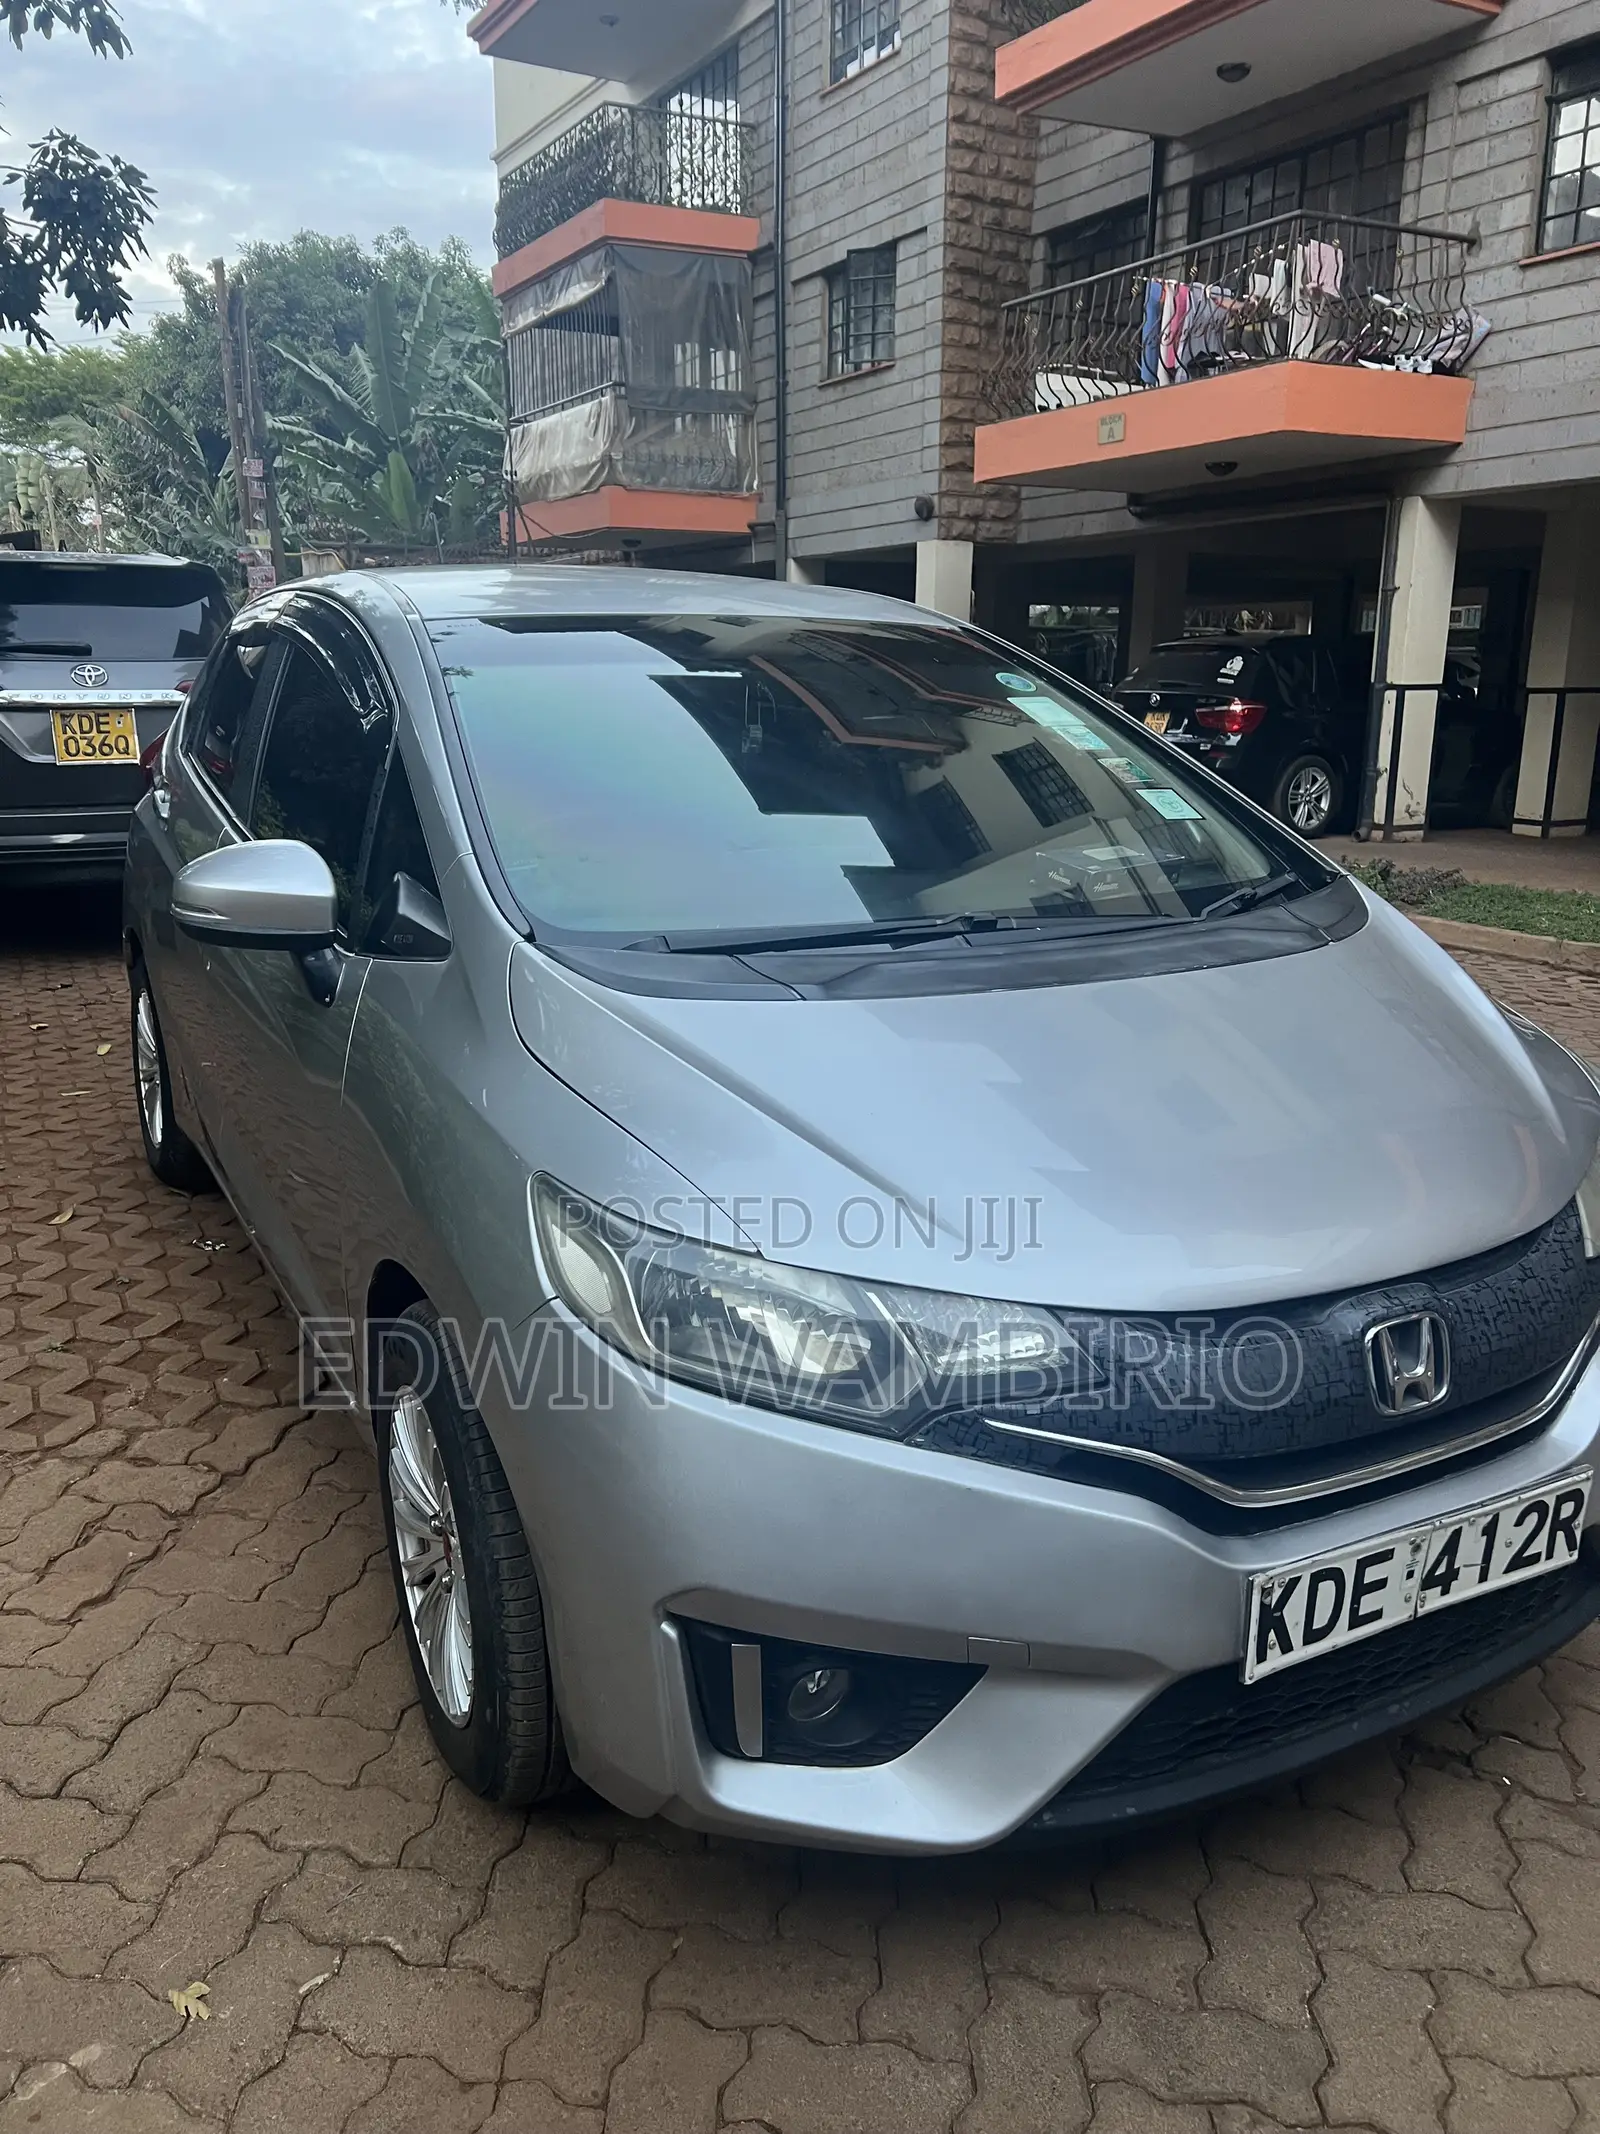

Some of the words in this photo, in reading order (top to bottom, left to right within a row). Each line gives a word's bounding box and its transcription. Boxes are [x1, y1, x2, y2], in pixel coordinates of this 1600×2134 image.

[1107, 427, 1116, 441] A
[60, 712, 111, 735] KDE
[63, 734, 131, 757] 036Q
[1255, 1547, 1396, 1665] KDE
[1419, 1488, 1585, 1597] 412R
